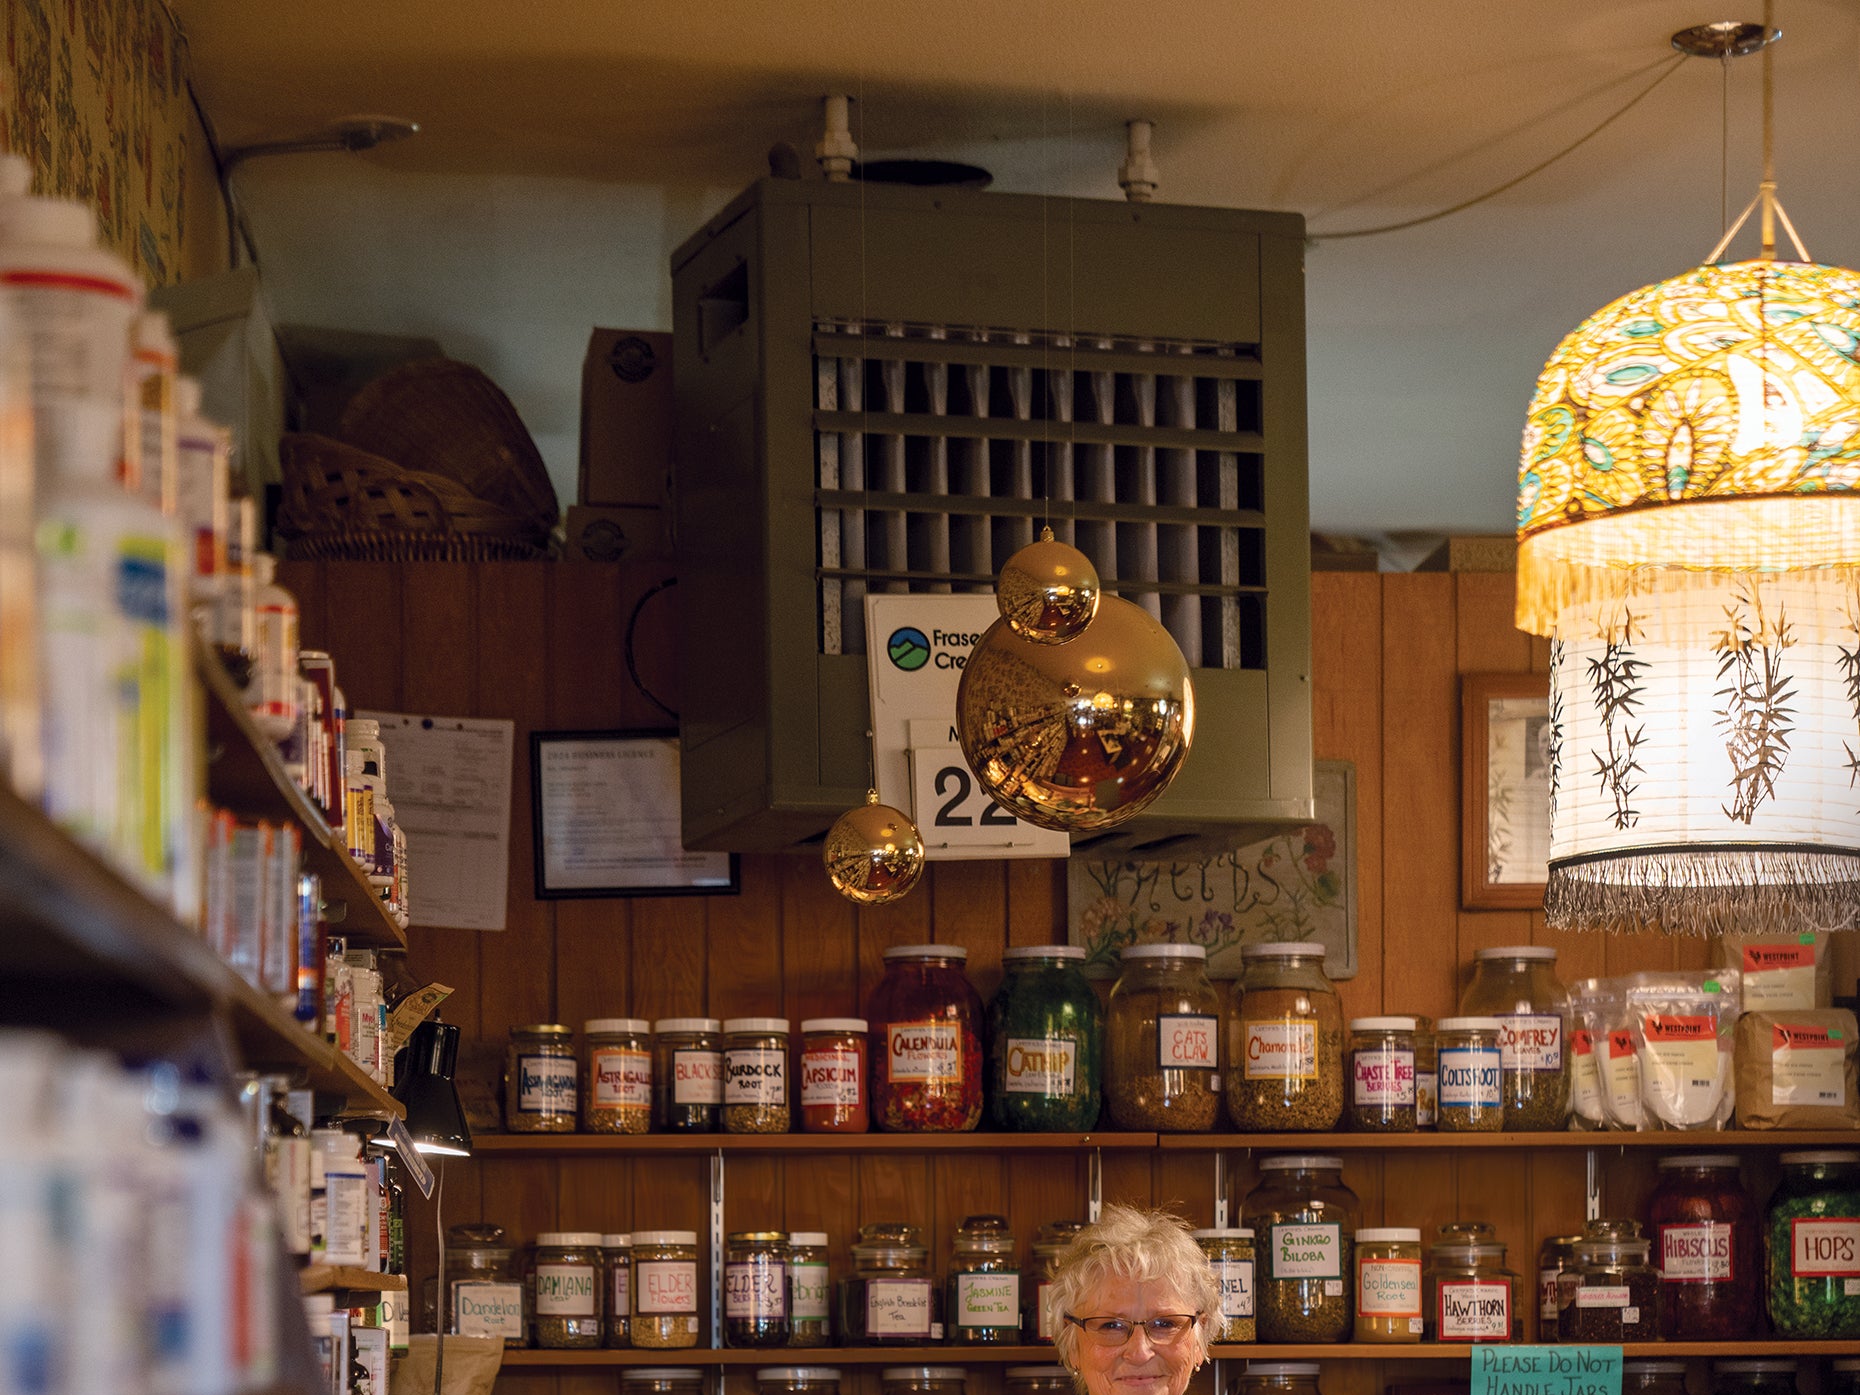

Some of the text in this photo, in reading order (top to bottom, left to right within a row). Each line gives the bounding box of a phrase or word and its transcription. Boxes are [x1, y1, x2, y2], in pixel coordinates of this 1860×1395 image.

[1171, 1044, 1210, 1061] CLAW
[675, 1063, 711, 1081] BLACK
[724, 1057, 783, 1086] BURDOCK
[738, 1080, 763, 1090] ROOT
[1282, 1233, 1332, 1246] GINKGO
[1664, 1233, 1729, 1259] HIBISCUS
[1804, 1235, 1854, 1261] HOPS
[1281, 1247, 1326, 1263] BILOBA
[537, 1275, 593, 1297] DAMIANA
[647, 1274, 694, 1294] ELDER
[726, 1274, 777, 1295] ELDER
[963, 1282, 1012, 1300] JASMINE
[1444, 1294, 1505, 1318] HAWTHORN
[1481, 1347, 1617, 1374] PLEASE DO NOT
